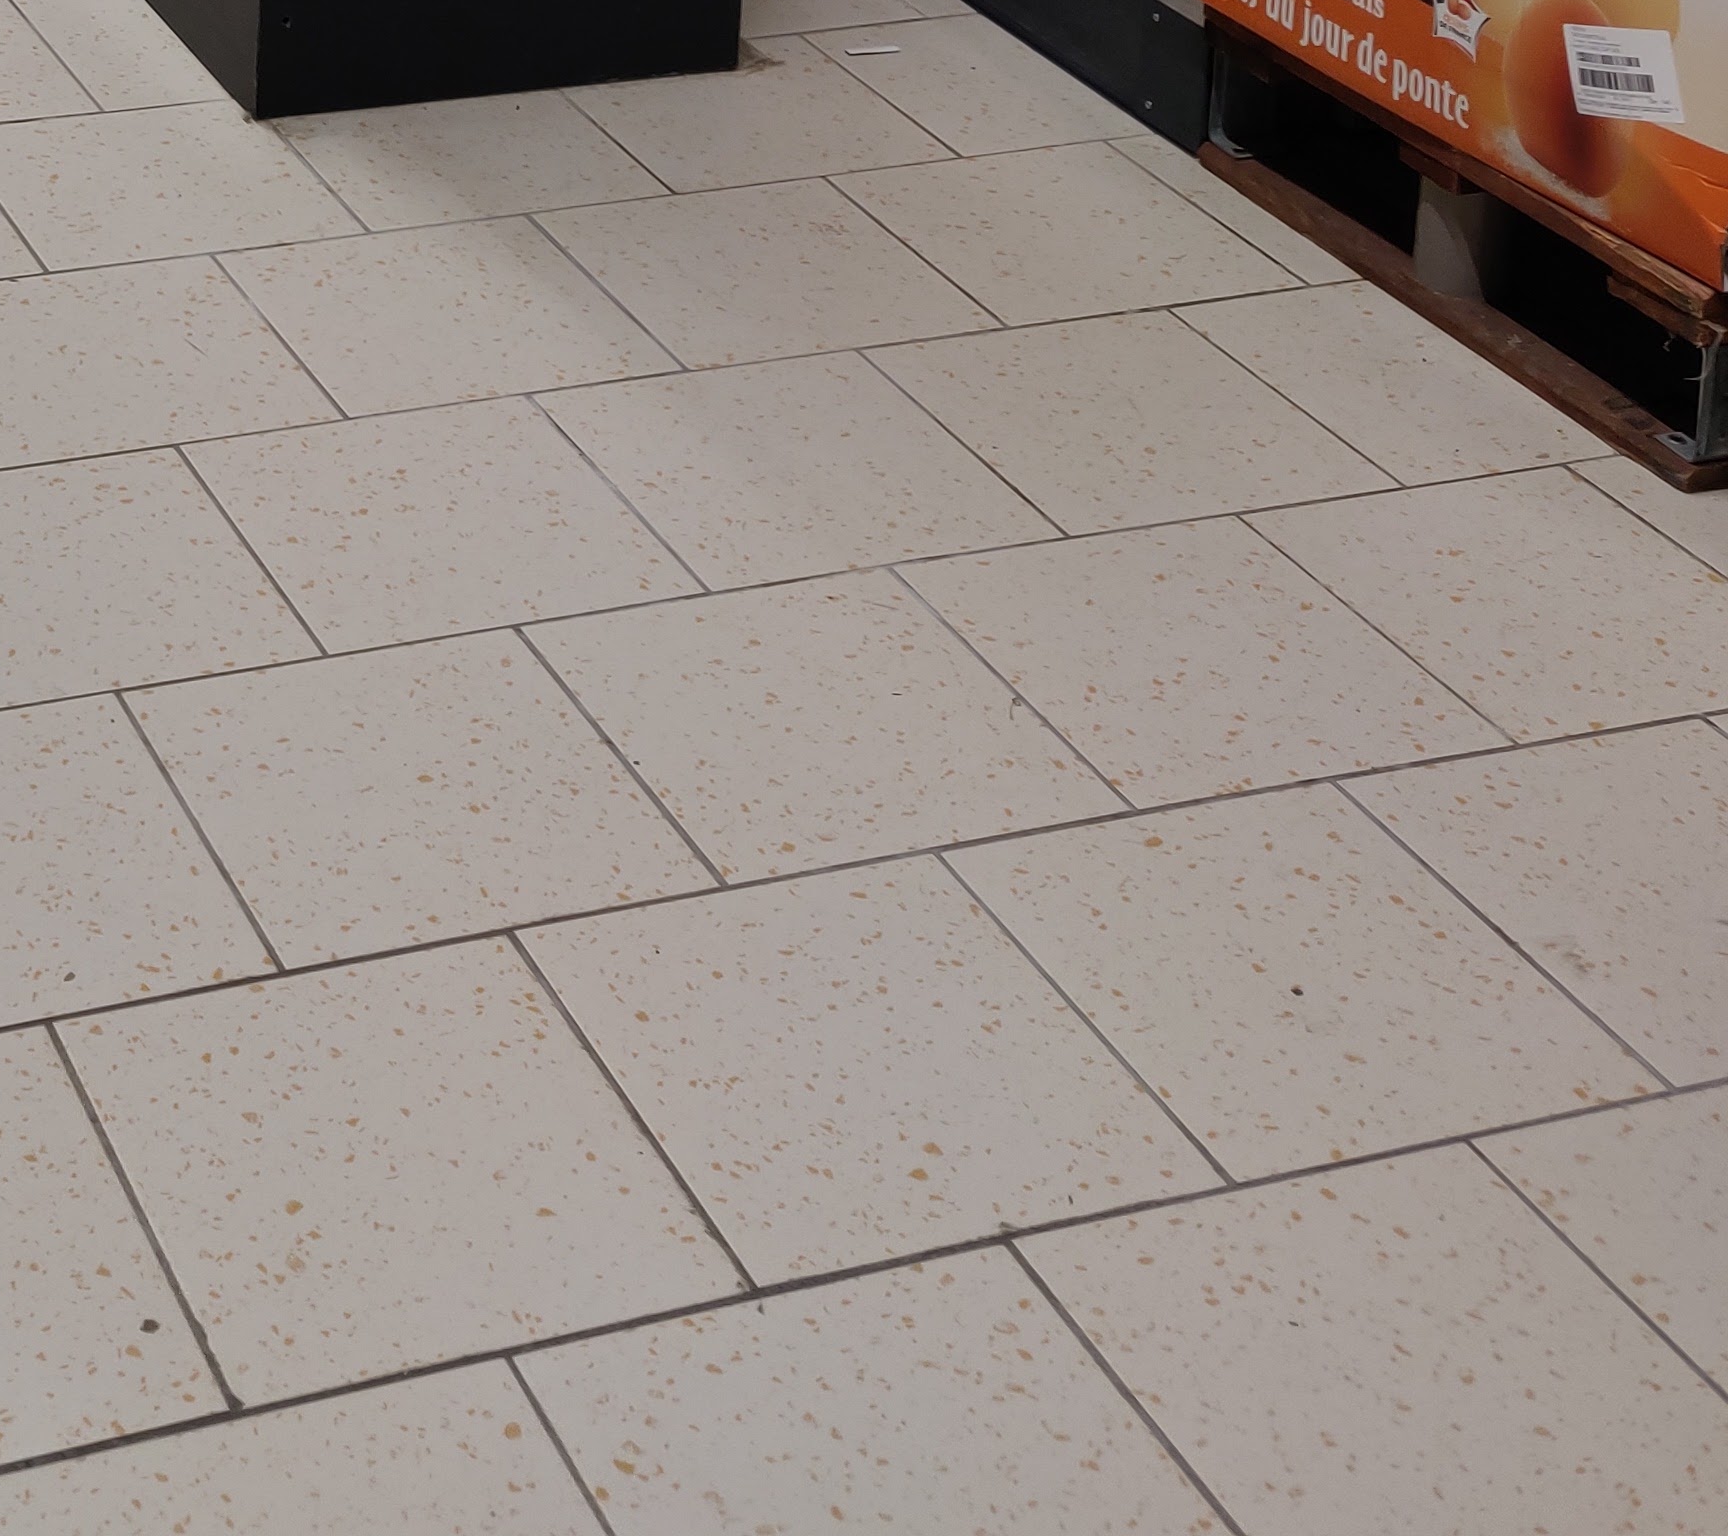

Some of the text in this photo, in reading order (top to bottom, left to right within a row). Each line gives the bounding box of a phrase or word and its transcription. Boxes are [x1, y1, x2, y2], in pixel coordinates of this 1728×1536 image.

[1299, 0, 1355, 63] jour
[1356, 32, 1389, 84] de
[1392, 58, 1470, 130] ponte
